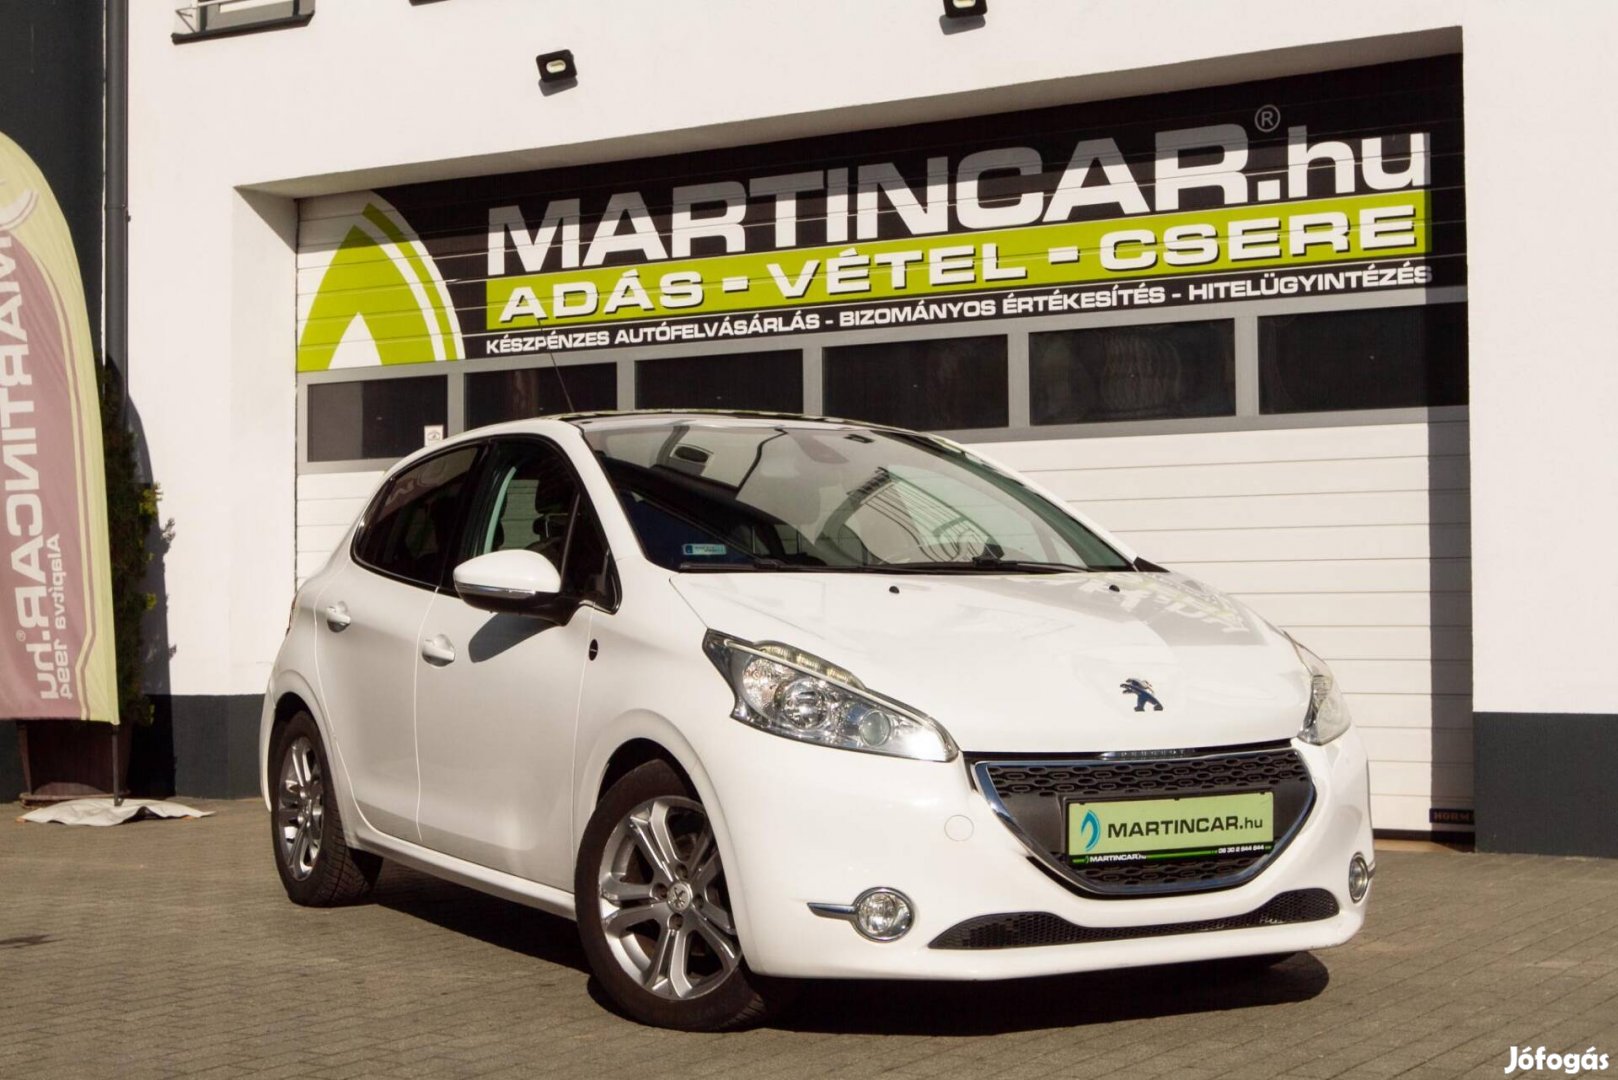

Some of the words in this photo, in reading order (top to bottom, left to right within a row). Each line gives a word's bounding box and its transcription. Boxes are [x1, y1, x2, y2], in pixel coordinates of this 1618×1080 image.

[485, 329, 611, 354] KÉSZPÉNZES
[614, 312, 820, 345] AUTÓFELVÁSÁRLÁS
[839, 299, 997, 327] BIZOMÁNYOS
[1002, 282, 1166, 315] ÉRTÉKESÍTÉS
[1187, 261, 1433, 302] HITELÜGYINTÉZÉS
[499, 268, 704, 323] ADÁS
[767, 242, 1027, 299] VÉTEL
[1099, 204, 1417, 272] CSERE
[1107, 815, 1263, 839] MARTINCAR.hu
